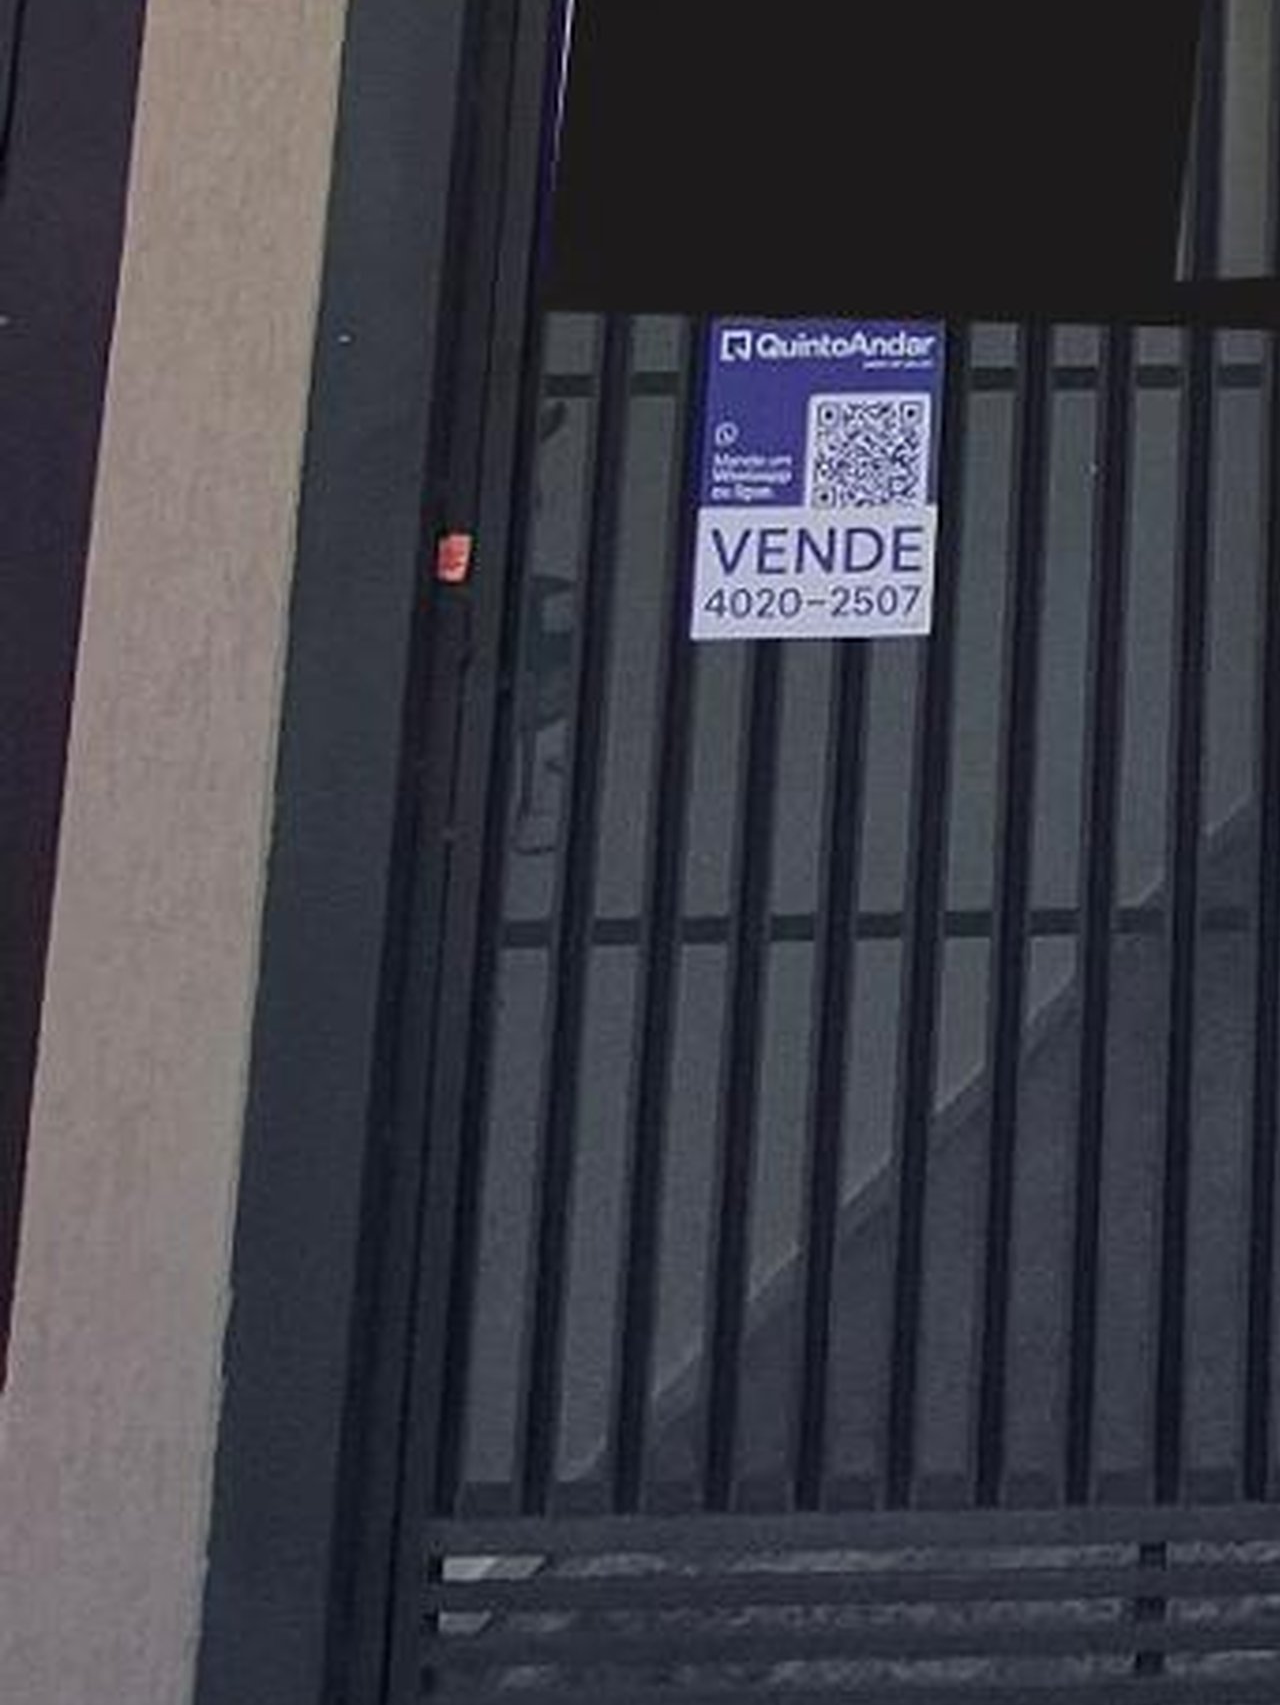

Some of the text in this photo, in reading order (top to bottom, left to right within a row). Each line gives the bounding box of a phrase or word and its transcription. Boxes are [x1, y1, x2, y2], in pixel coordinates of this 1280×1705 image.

[756, 331, 936, 359] QuintoAndar
[711, 526, 924, 576] VENDE
[703, 585, 923, 620] 4020-2507
